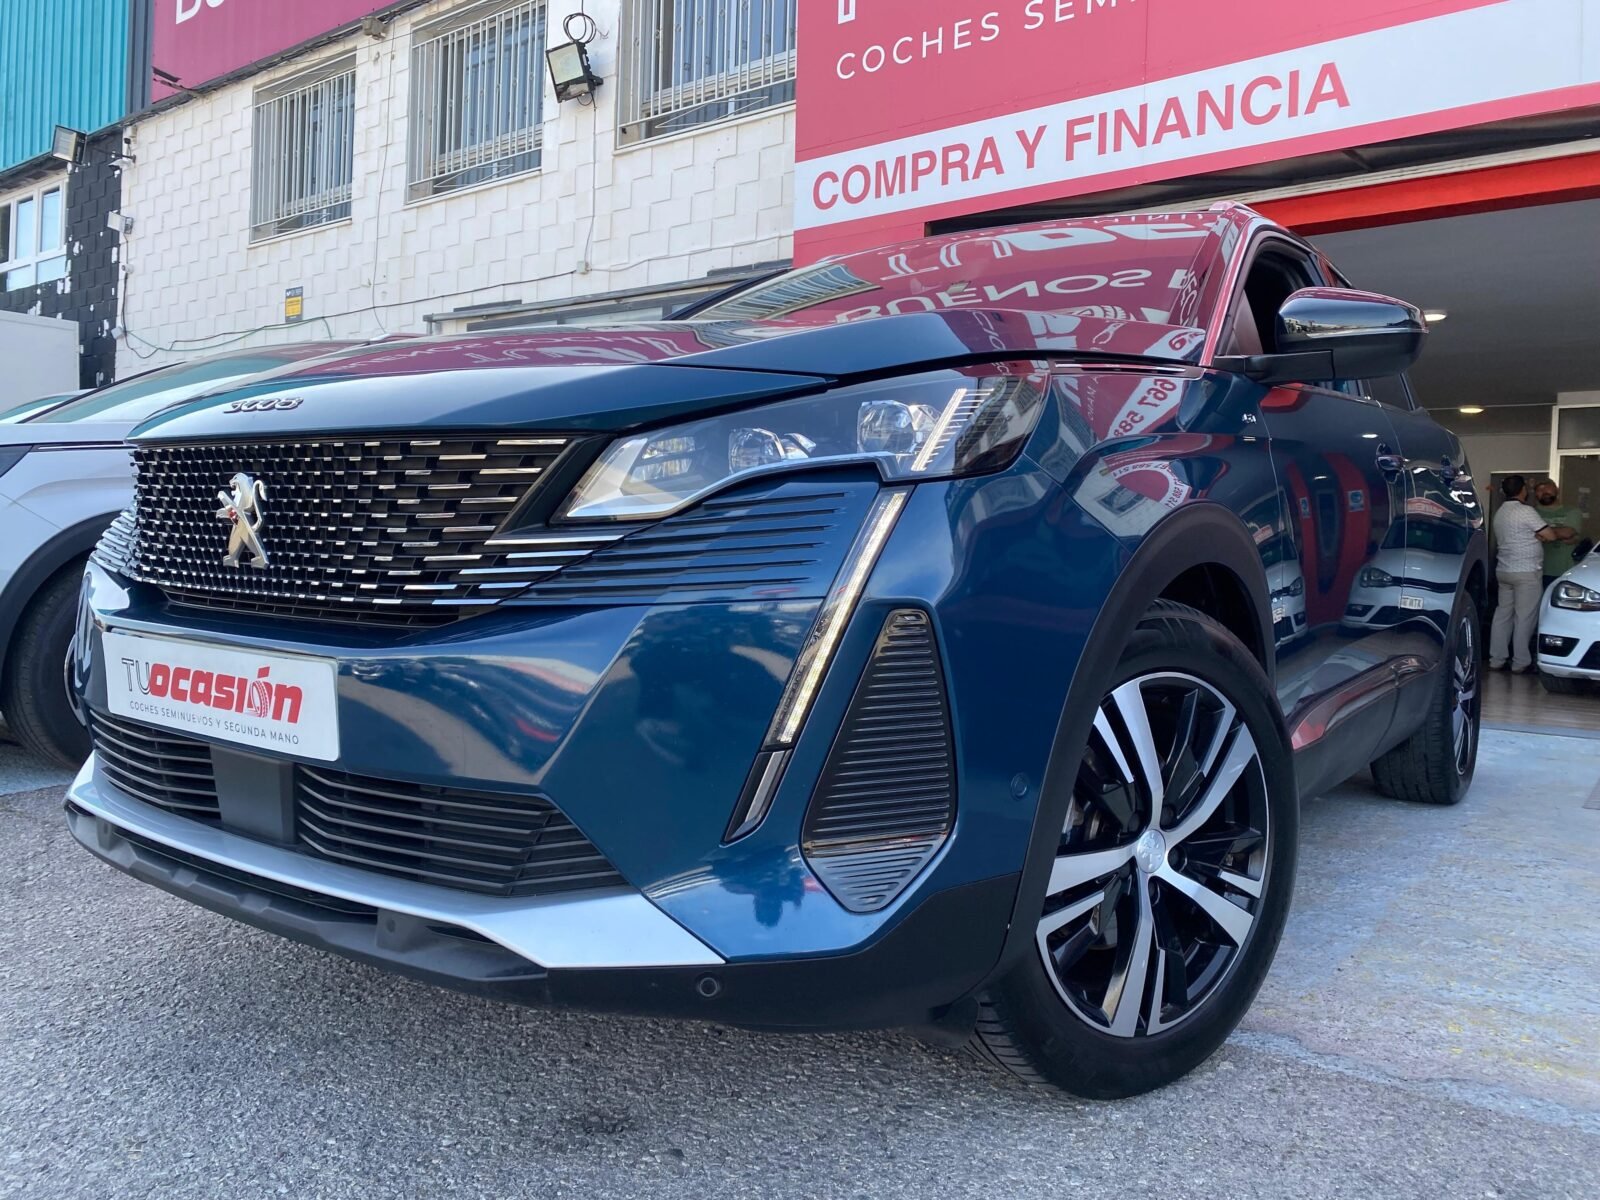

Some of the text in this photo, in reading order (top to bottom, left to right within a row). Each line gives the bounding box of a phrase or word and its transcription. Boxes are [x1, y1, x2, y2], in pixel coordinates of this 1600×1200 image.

[836, 11, 1000, 80] COCHES
[812, 61, 1350, 211] COMPRA Y FINANCIA
[129, 700, 299, 745] COCHES SEMINUEVOS Y SEGUNDA MANO
